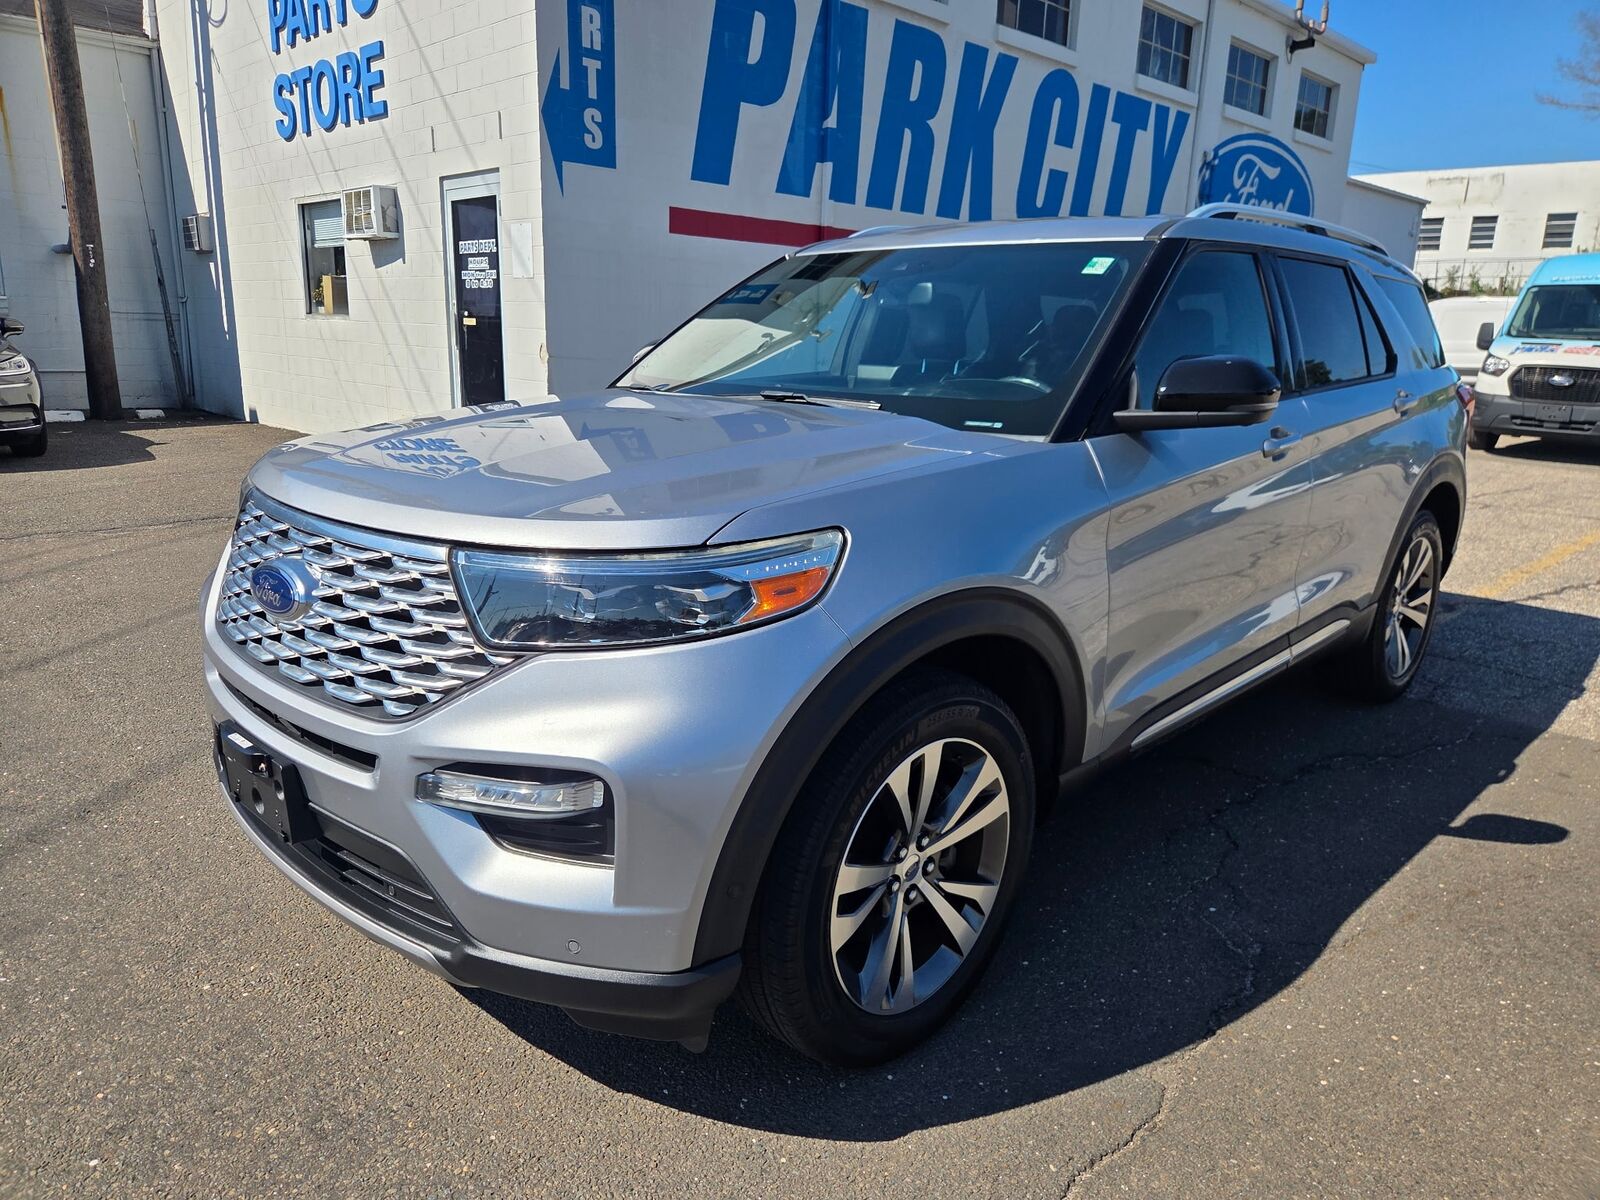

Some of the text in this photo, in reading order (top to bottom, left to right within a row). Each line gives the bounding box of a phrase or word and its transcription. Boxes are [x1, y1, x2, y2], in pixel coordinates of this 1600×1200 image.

[268, 0, 380, 55] PAR
[273, 40, 389, 142] STORE
[690, 0, 1191, 222] PARK CITY
[1224, 153, 1294, 212] Fd
[459, 240, 478, 254] PARTS
[468, 257, 489, 267] HOURS
[256, 574, 284, 606] Ford
